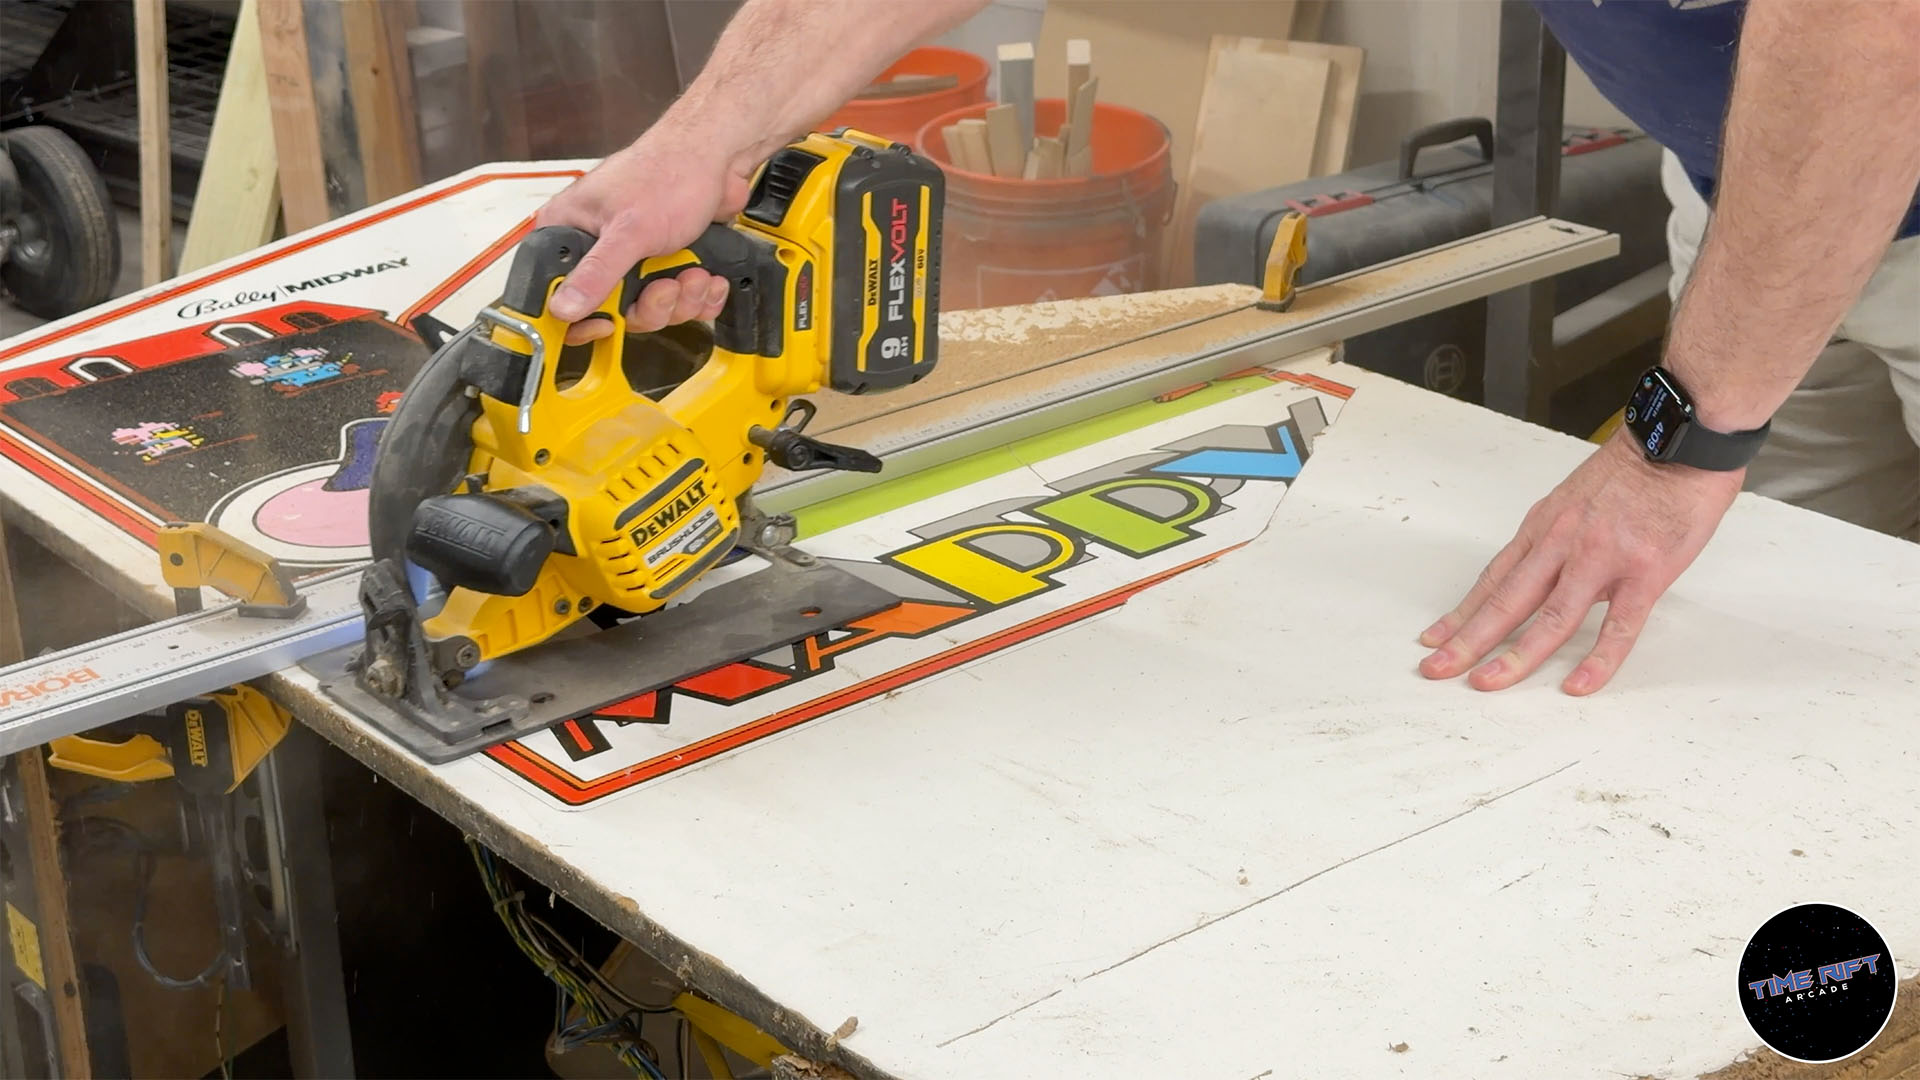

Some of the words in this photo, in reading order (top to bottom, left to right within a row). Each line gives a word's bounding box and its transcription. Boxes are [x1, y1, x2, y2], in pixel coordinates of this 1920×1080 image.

[285, 257, 410, 293] MIDWAY
[888, 198, 908, 321] FLEXVOLT
[881, 337, 901, 359] 9
[1647, 421, 1664, 451] 4:09
[648, 510, 715, 564] BRUSHLESS
